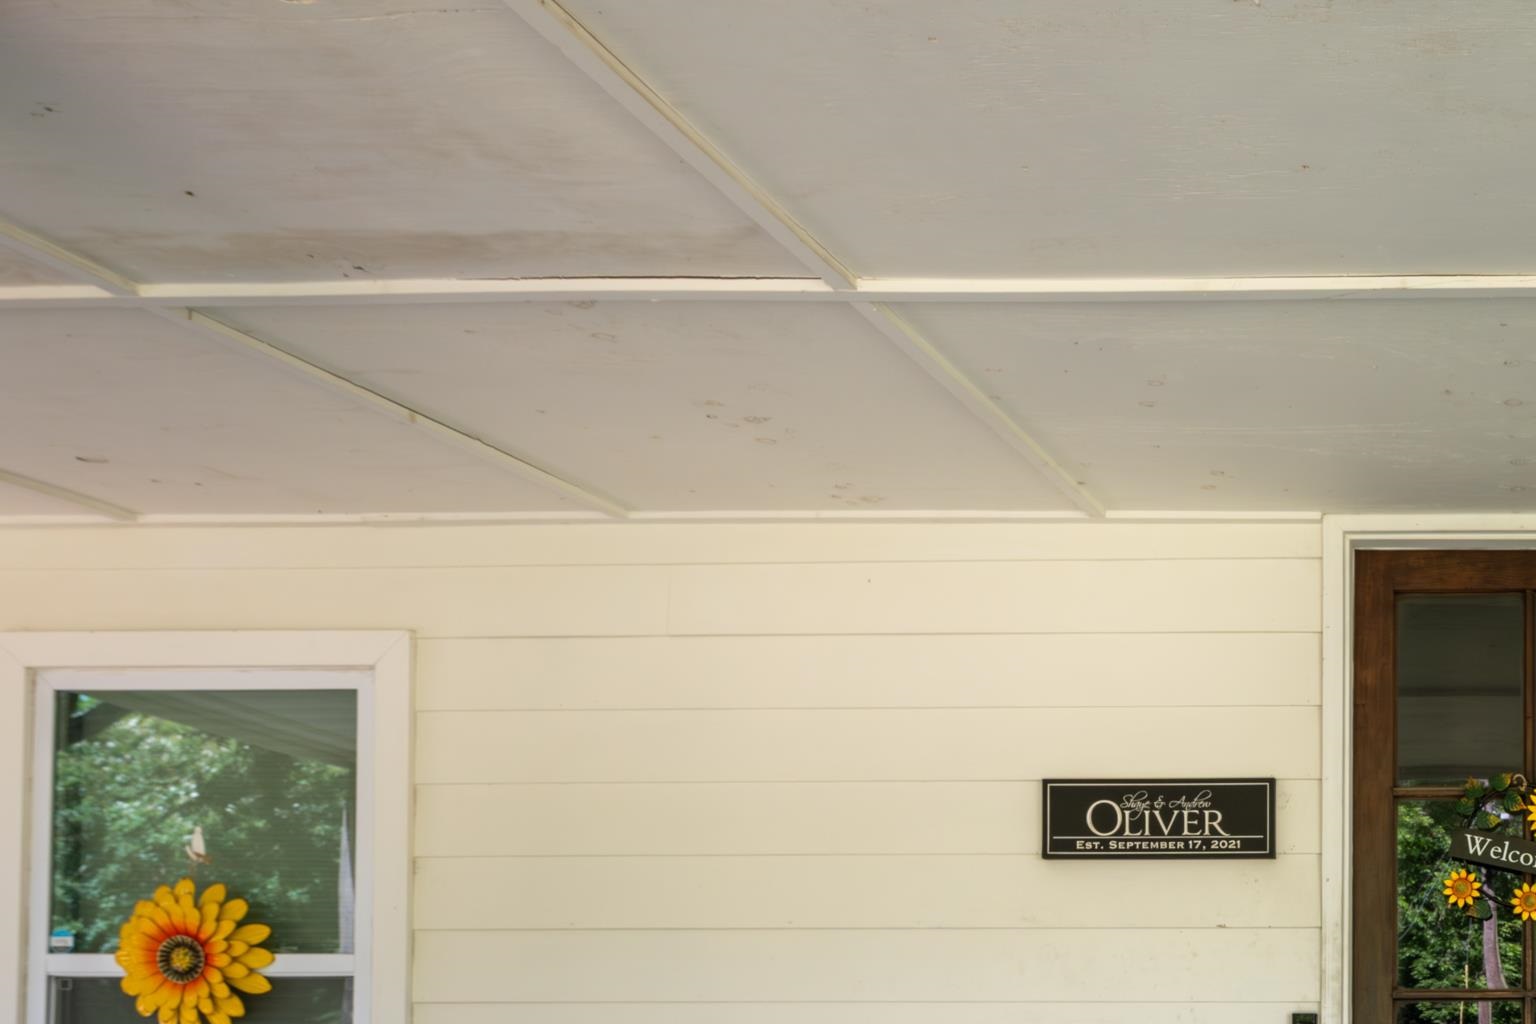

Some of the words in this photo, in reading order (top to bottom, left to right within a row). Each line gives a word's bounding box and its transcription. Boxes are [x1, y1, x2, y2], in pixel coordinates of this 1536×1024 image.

[1153, 795, 1167, 810] &
[1086, 799, 1231, 837] OLIVER
[1076, 840, 1105, 850] EST.
[1109, 840, 1185, 850] SEPTEMBER
[1188, 839, 1206, 851] 17,
[1210, 839, 1242, 850] 2021
